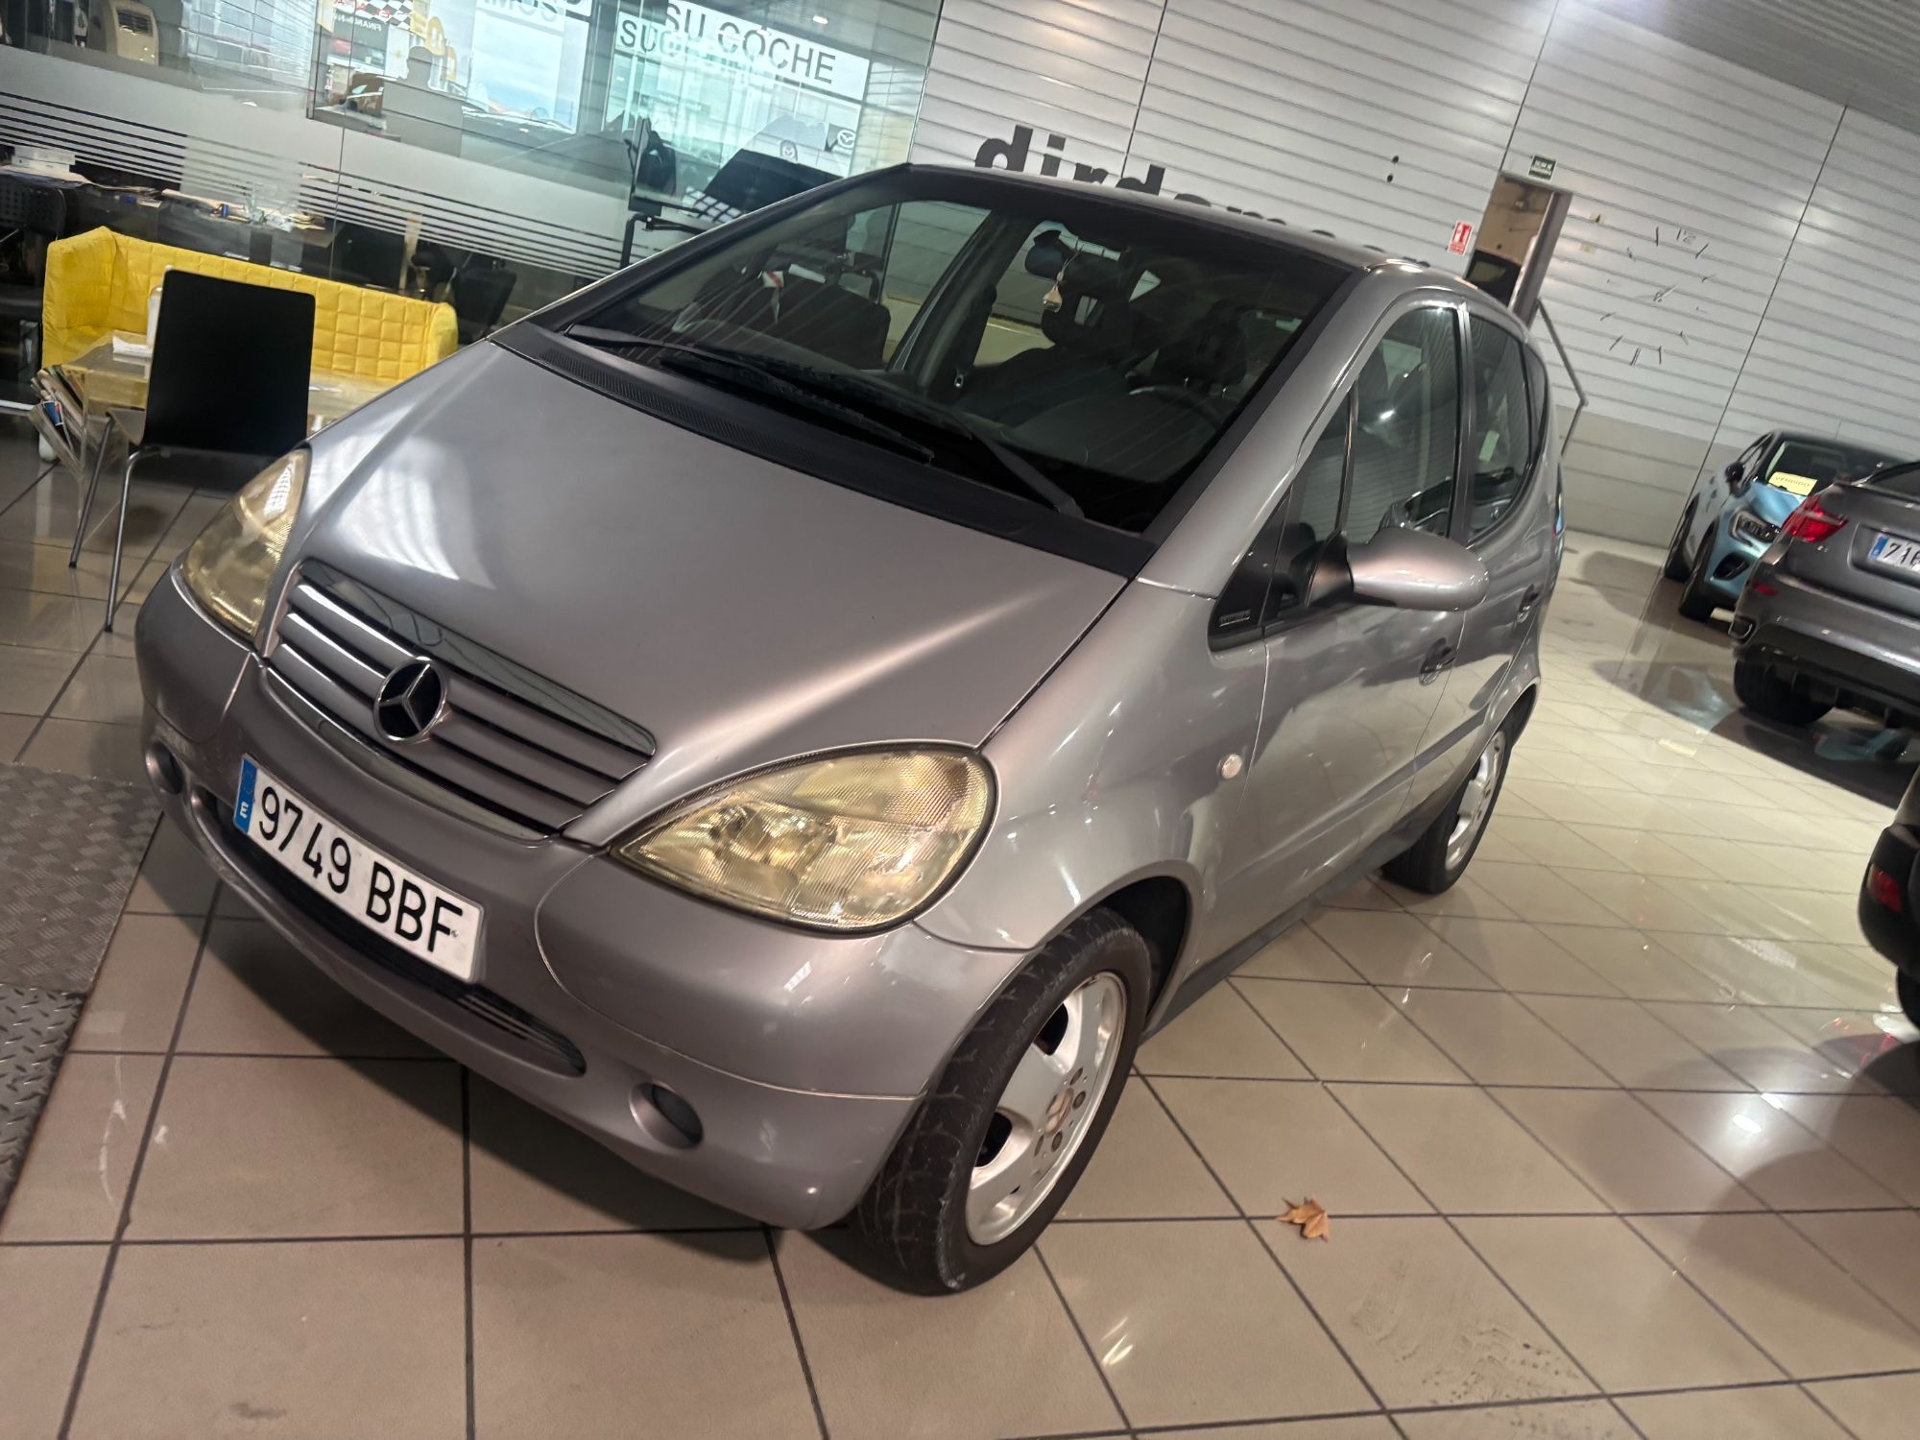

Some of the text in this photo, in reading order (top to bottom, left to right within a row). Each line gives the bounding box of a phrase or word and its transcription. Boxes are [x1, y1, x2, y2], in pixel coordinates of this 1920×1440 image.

[717, 21, 836, 85] COCHE
[259, 786, 463, 953] 9749 BBF
